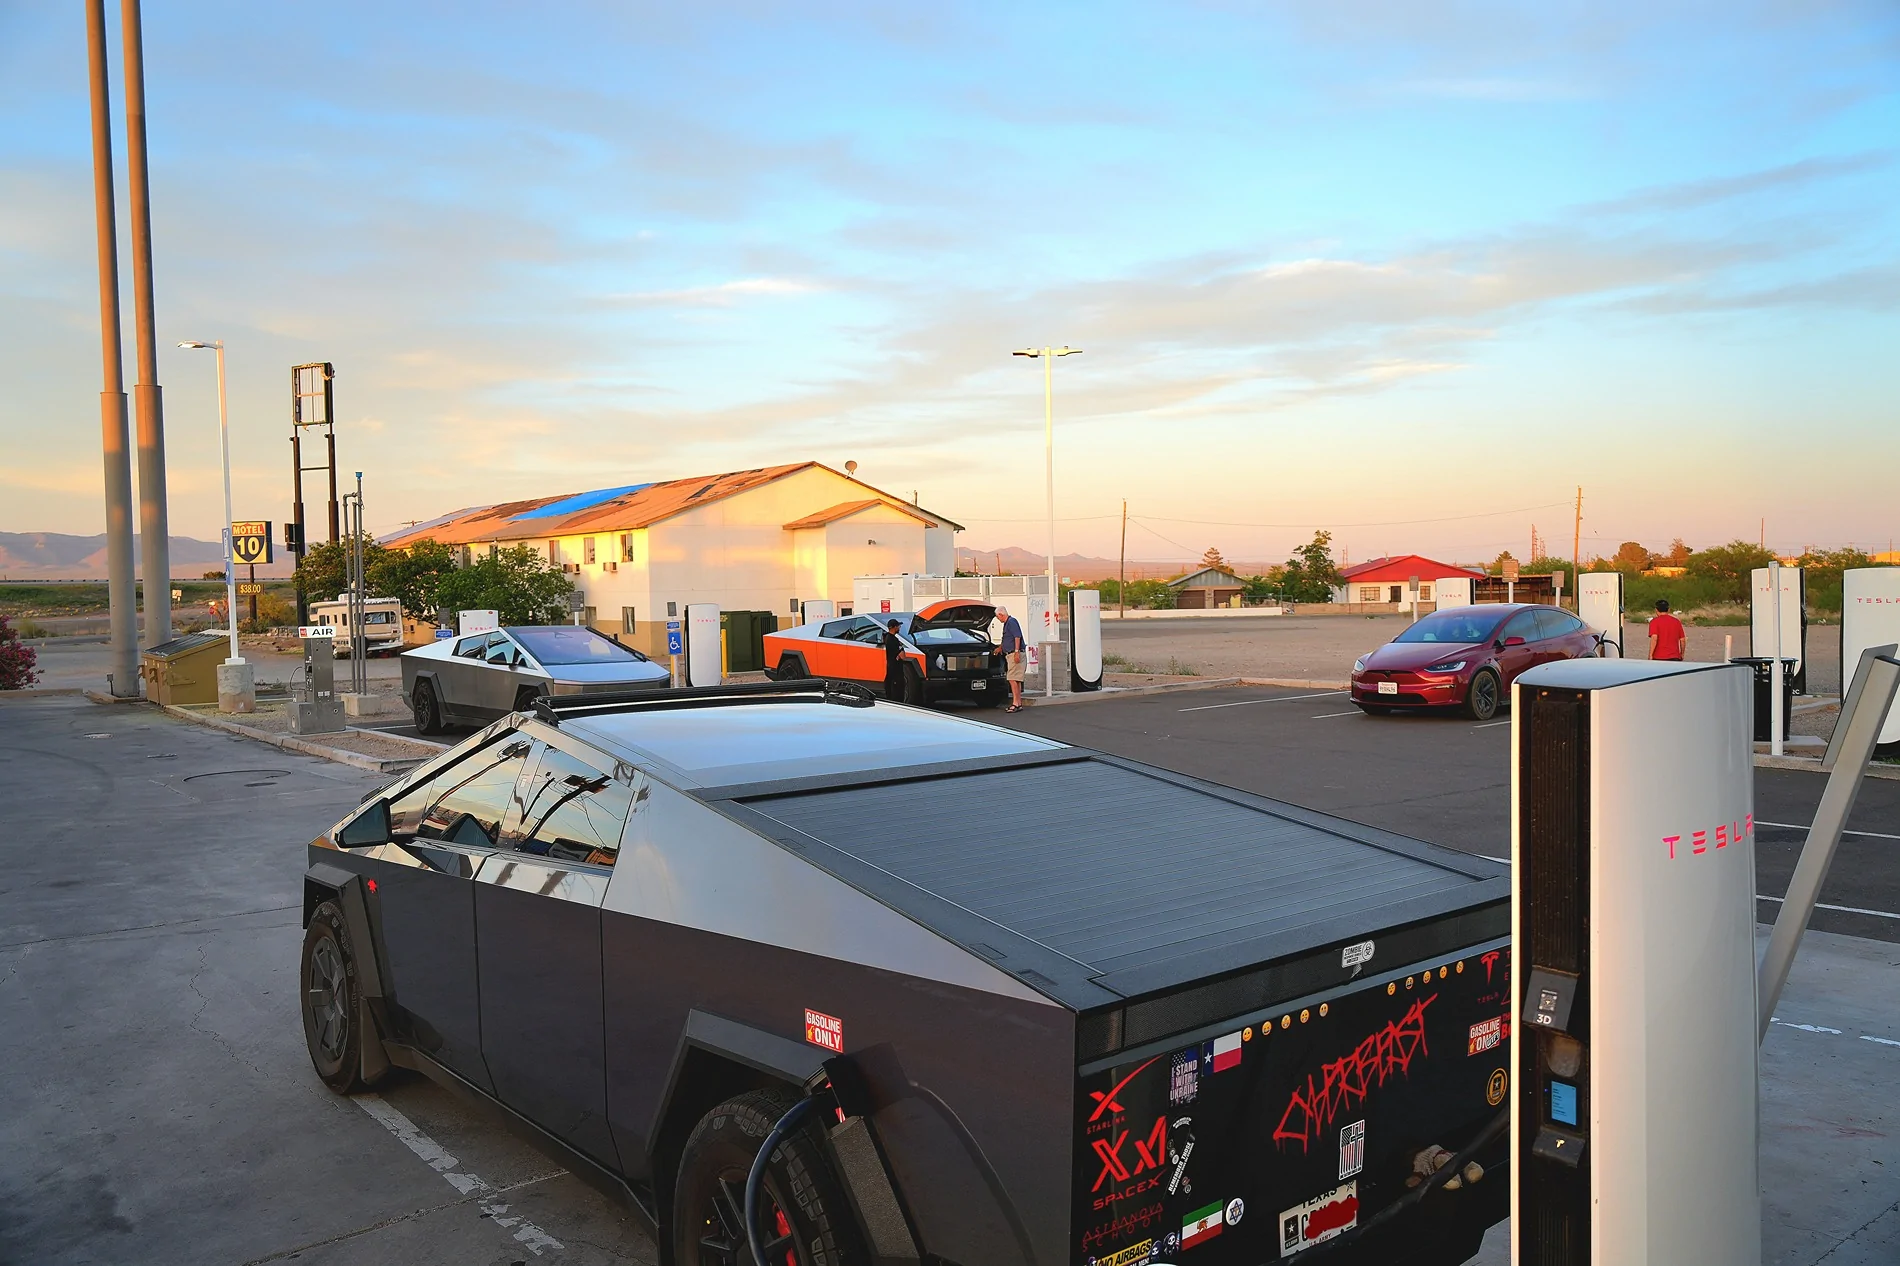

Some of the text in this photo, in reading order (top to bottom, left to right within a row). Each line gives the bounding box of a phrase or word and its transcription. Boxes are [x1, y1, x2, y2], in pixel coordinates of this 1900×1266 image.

[233, 525, 263, 534] MOTEL
[237, 536, 260, 555] 10
[240, 584, 261, 593] $38.00
[312, 628, 334, 636] AIR
[1662, 813, 1753, 860] TESLA
[806, 1011, 841, 1034] GASOLINE
[1470, 1019, 1500, 1039] GASOLINE
[1536, 1013, 1553, 1025] 3D
[814, 1027, 841, 1050] ONLY
[1175, 1059, 1198, 1076] STAND
[1175, 1072, 1193, 1088] WITH
[1170, 1081, 1199, 1101] UKRAINE
[1086, 1115, 1126, 1135] STARLINK
[1093, 1168, 1168, 1211] SPACEX
[1115, 1240, 1152, 1265] AIRBAGS
